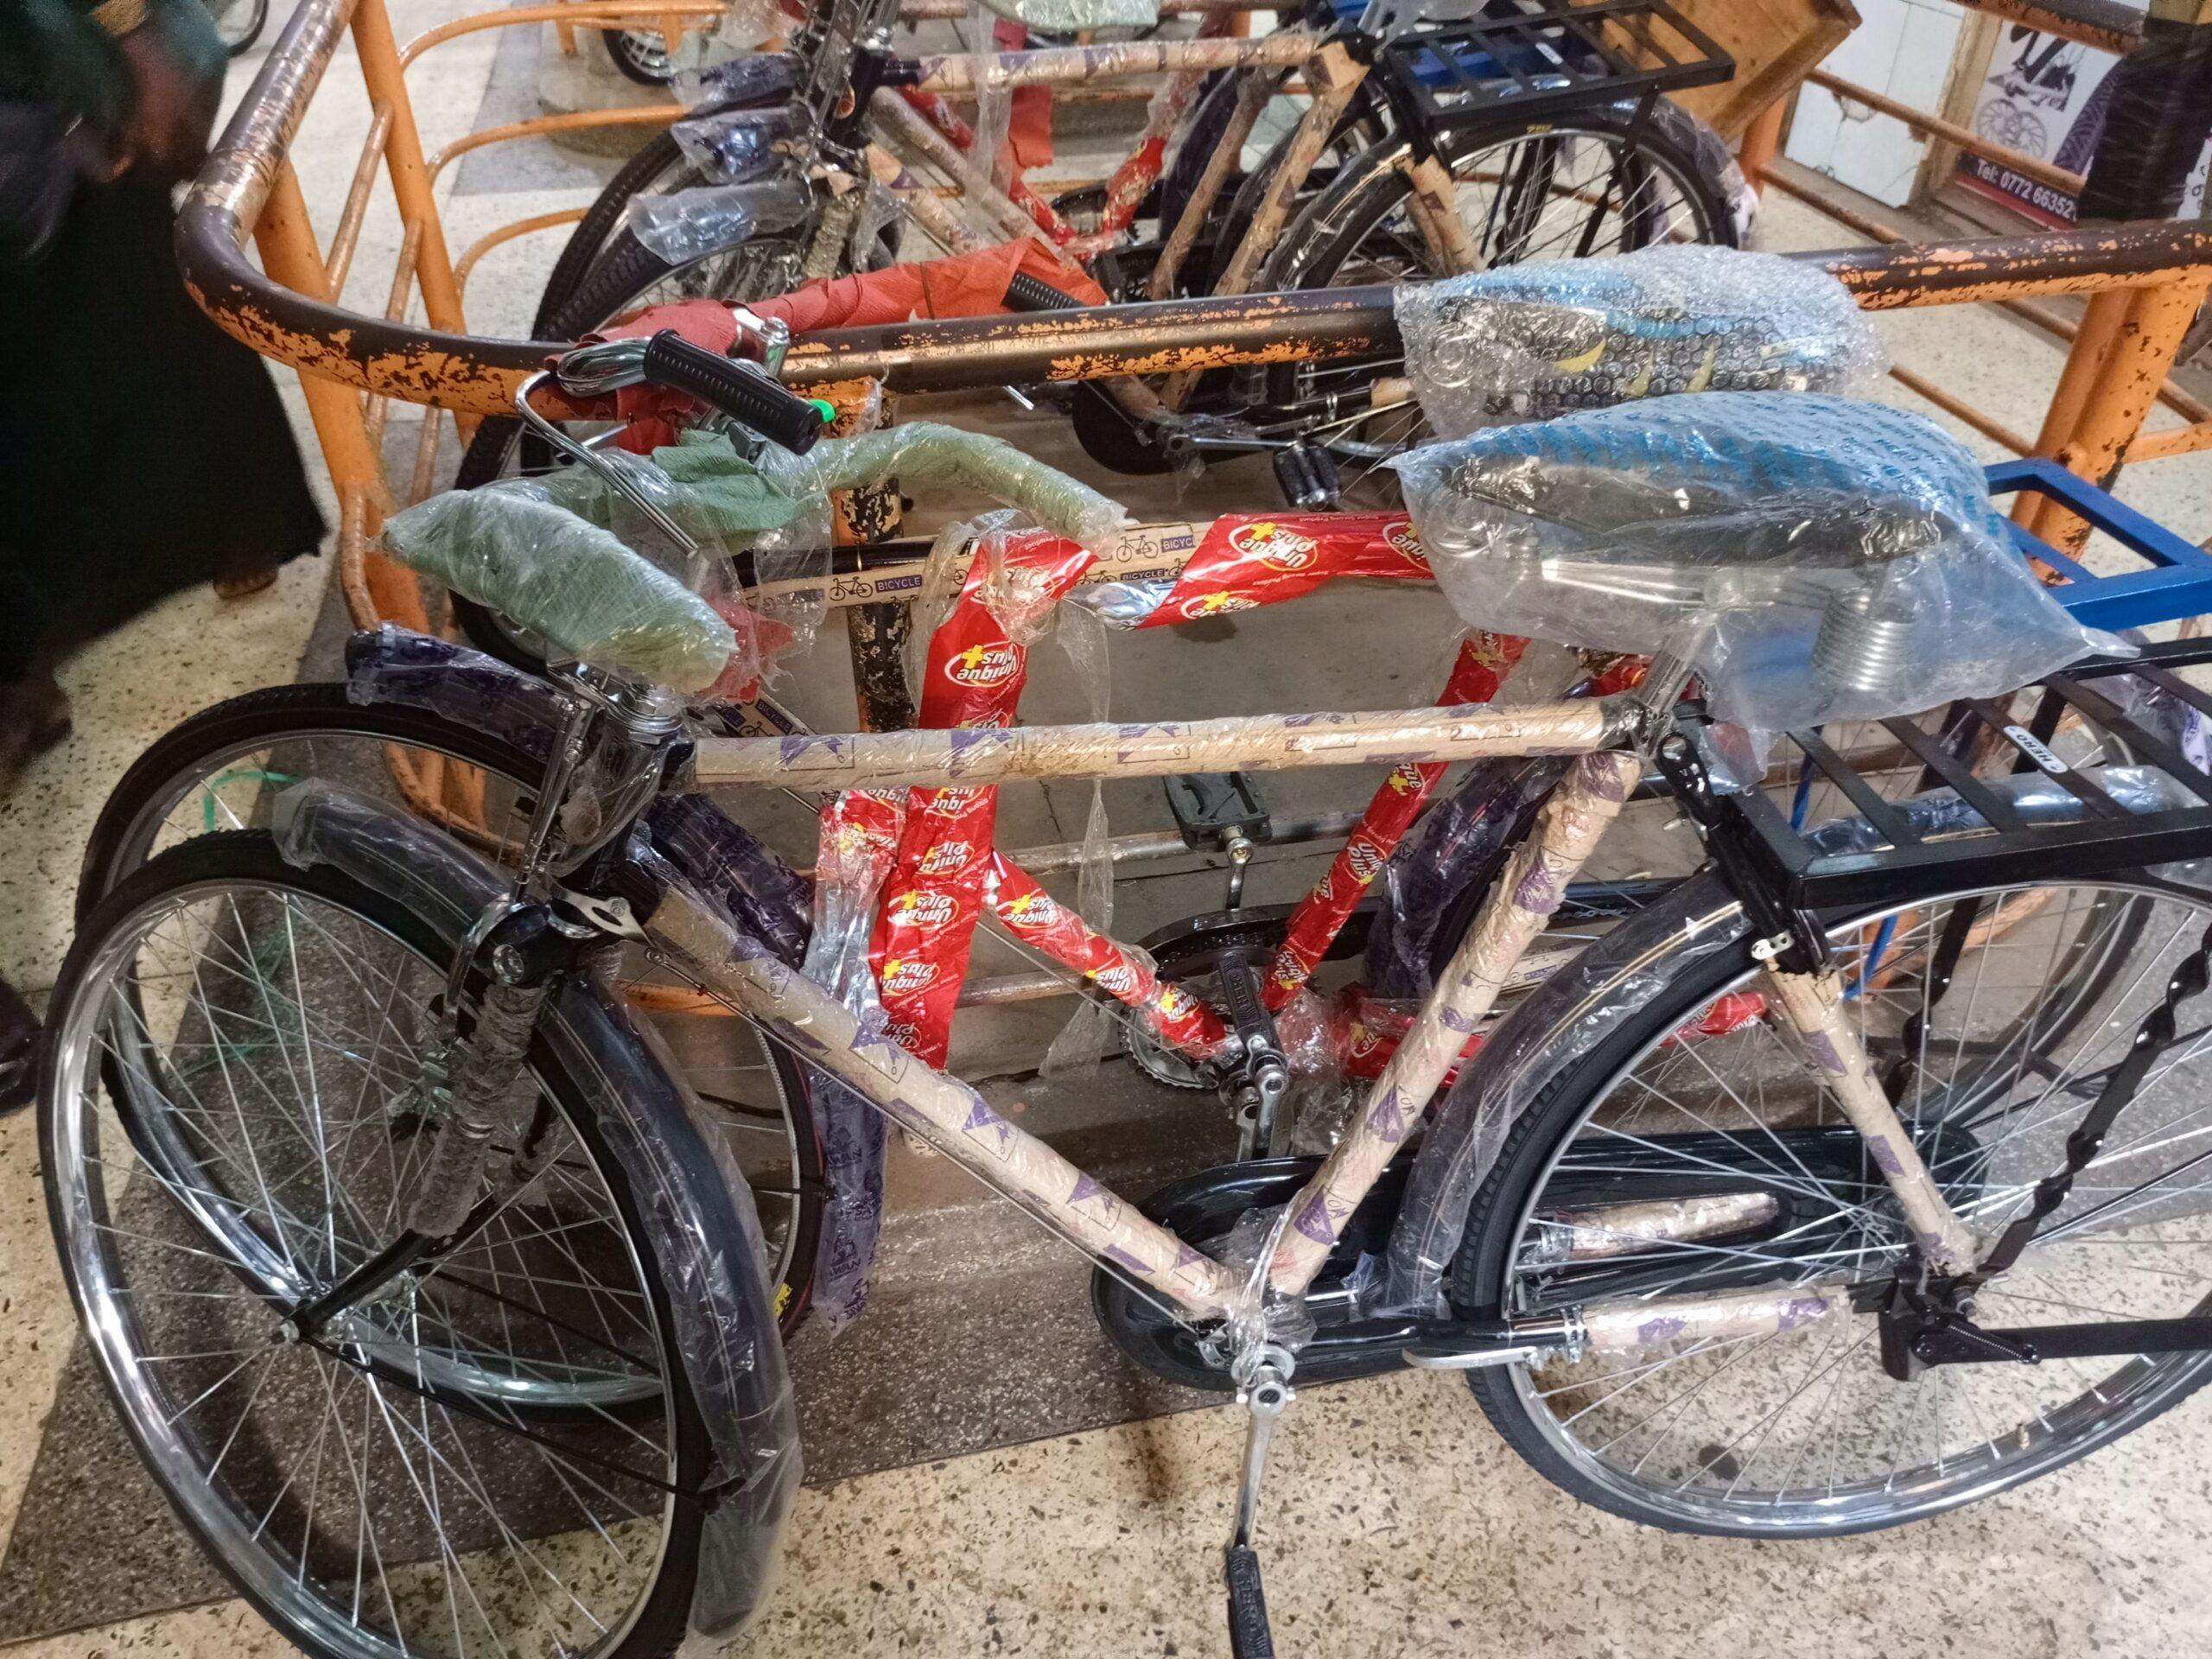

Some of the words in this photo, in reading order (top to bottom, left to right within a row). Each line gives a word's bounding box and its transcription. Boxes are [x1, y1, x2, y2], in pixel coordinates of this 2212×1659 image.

[1977, 159, 1998, 183] Tel:
[2000, 171, 2033, 200] 0772
[1163, 537, 1194, 550] BICYC
[1239, 537, 1308, 568] Unique
[1392, 533, 1427, 561] ique
[877, 577, 922, 591] BICYCLE
[1122, 569, 1164, 581] BICYCLE
[956, 654, 1018, 681] Unique
[2016, 734, 2053, 761] HERO
